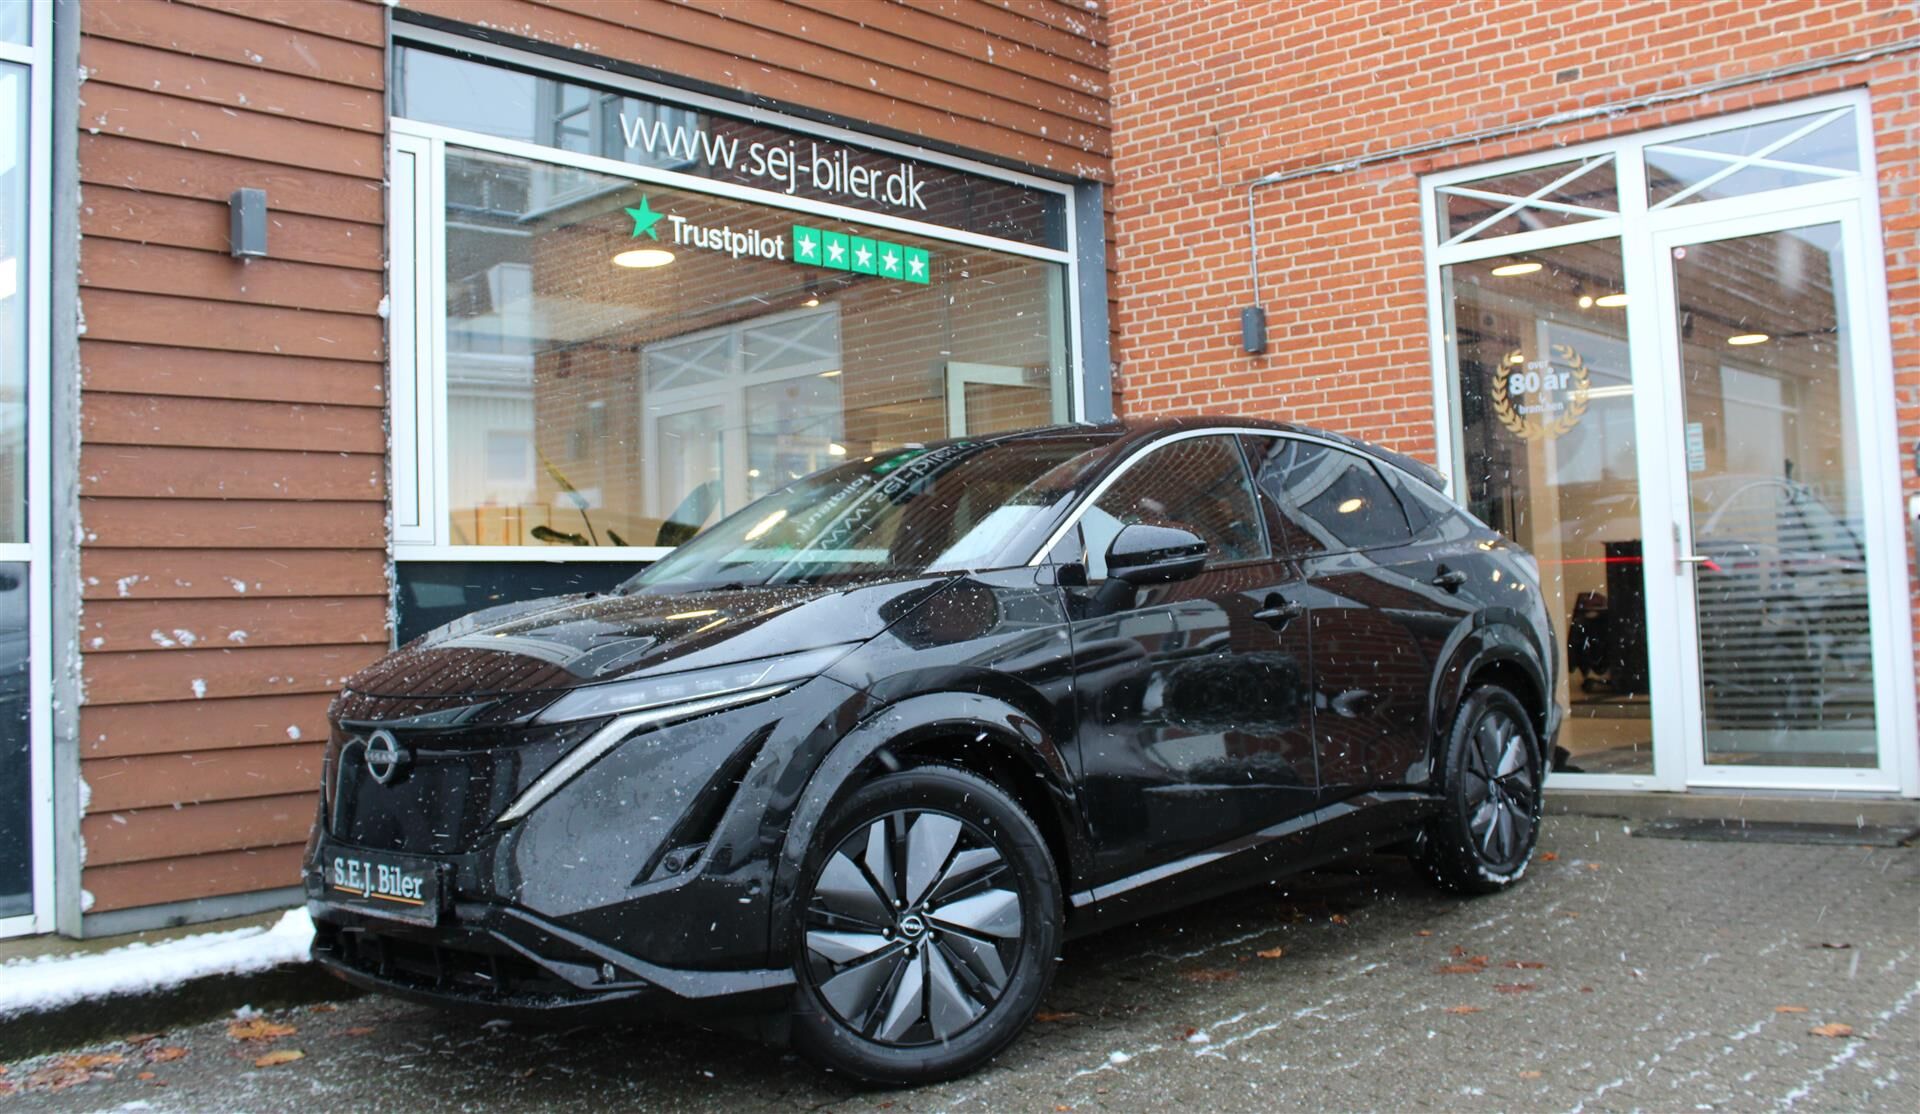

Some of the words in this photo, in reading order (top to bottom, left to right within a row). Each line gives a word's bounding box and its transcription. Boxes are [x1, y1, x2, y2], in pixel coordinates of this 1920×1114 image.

[620, 112, 927, 211] www.sej-biler.dk
[668, 214, 785, 261] Trustpilot
[1509, 371, 1540, 395] 80
[1543, 367, 1570, 390] år
[334, 857, 375, 898] S.E.J.
[378, 864, 423, 899] Biler
